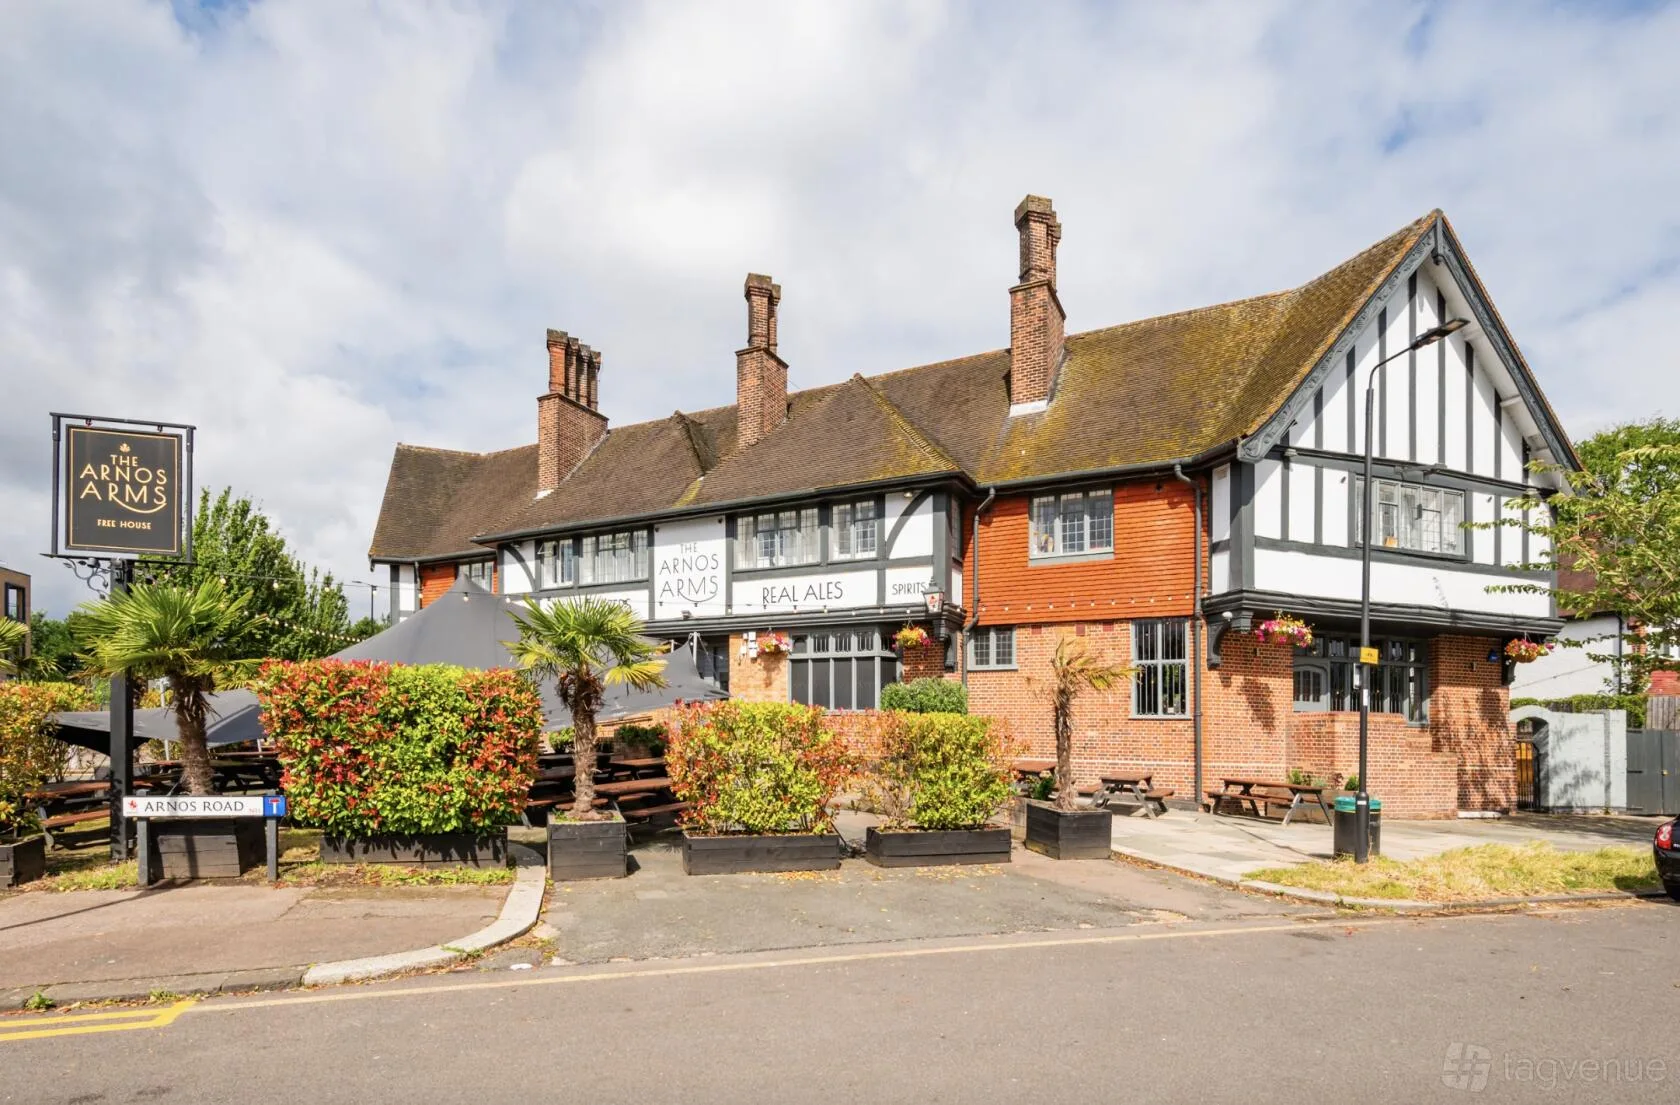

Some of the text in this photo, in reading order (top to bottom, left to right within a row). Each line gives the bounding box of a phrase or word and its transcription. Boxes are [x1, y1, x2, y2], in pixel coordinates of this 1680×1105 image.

[110, 454, 139, 467] THE
[79, 463, 168, 485] ARNOS
[79, 481, 168, 513] ARMS
[97, 519, 152, 530] FREE HOUSE
[680, 542, 697, 554] THE
[658, 553, 719, 575] ARNOS
[659, 575, 719, 603] ARMS
[762, 581, 844, 605] REAL ALES
[144, 800, 245, 812] ARNOS ROAD
